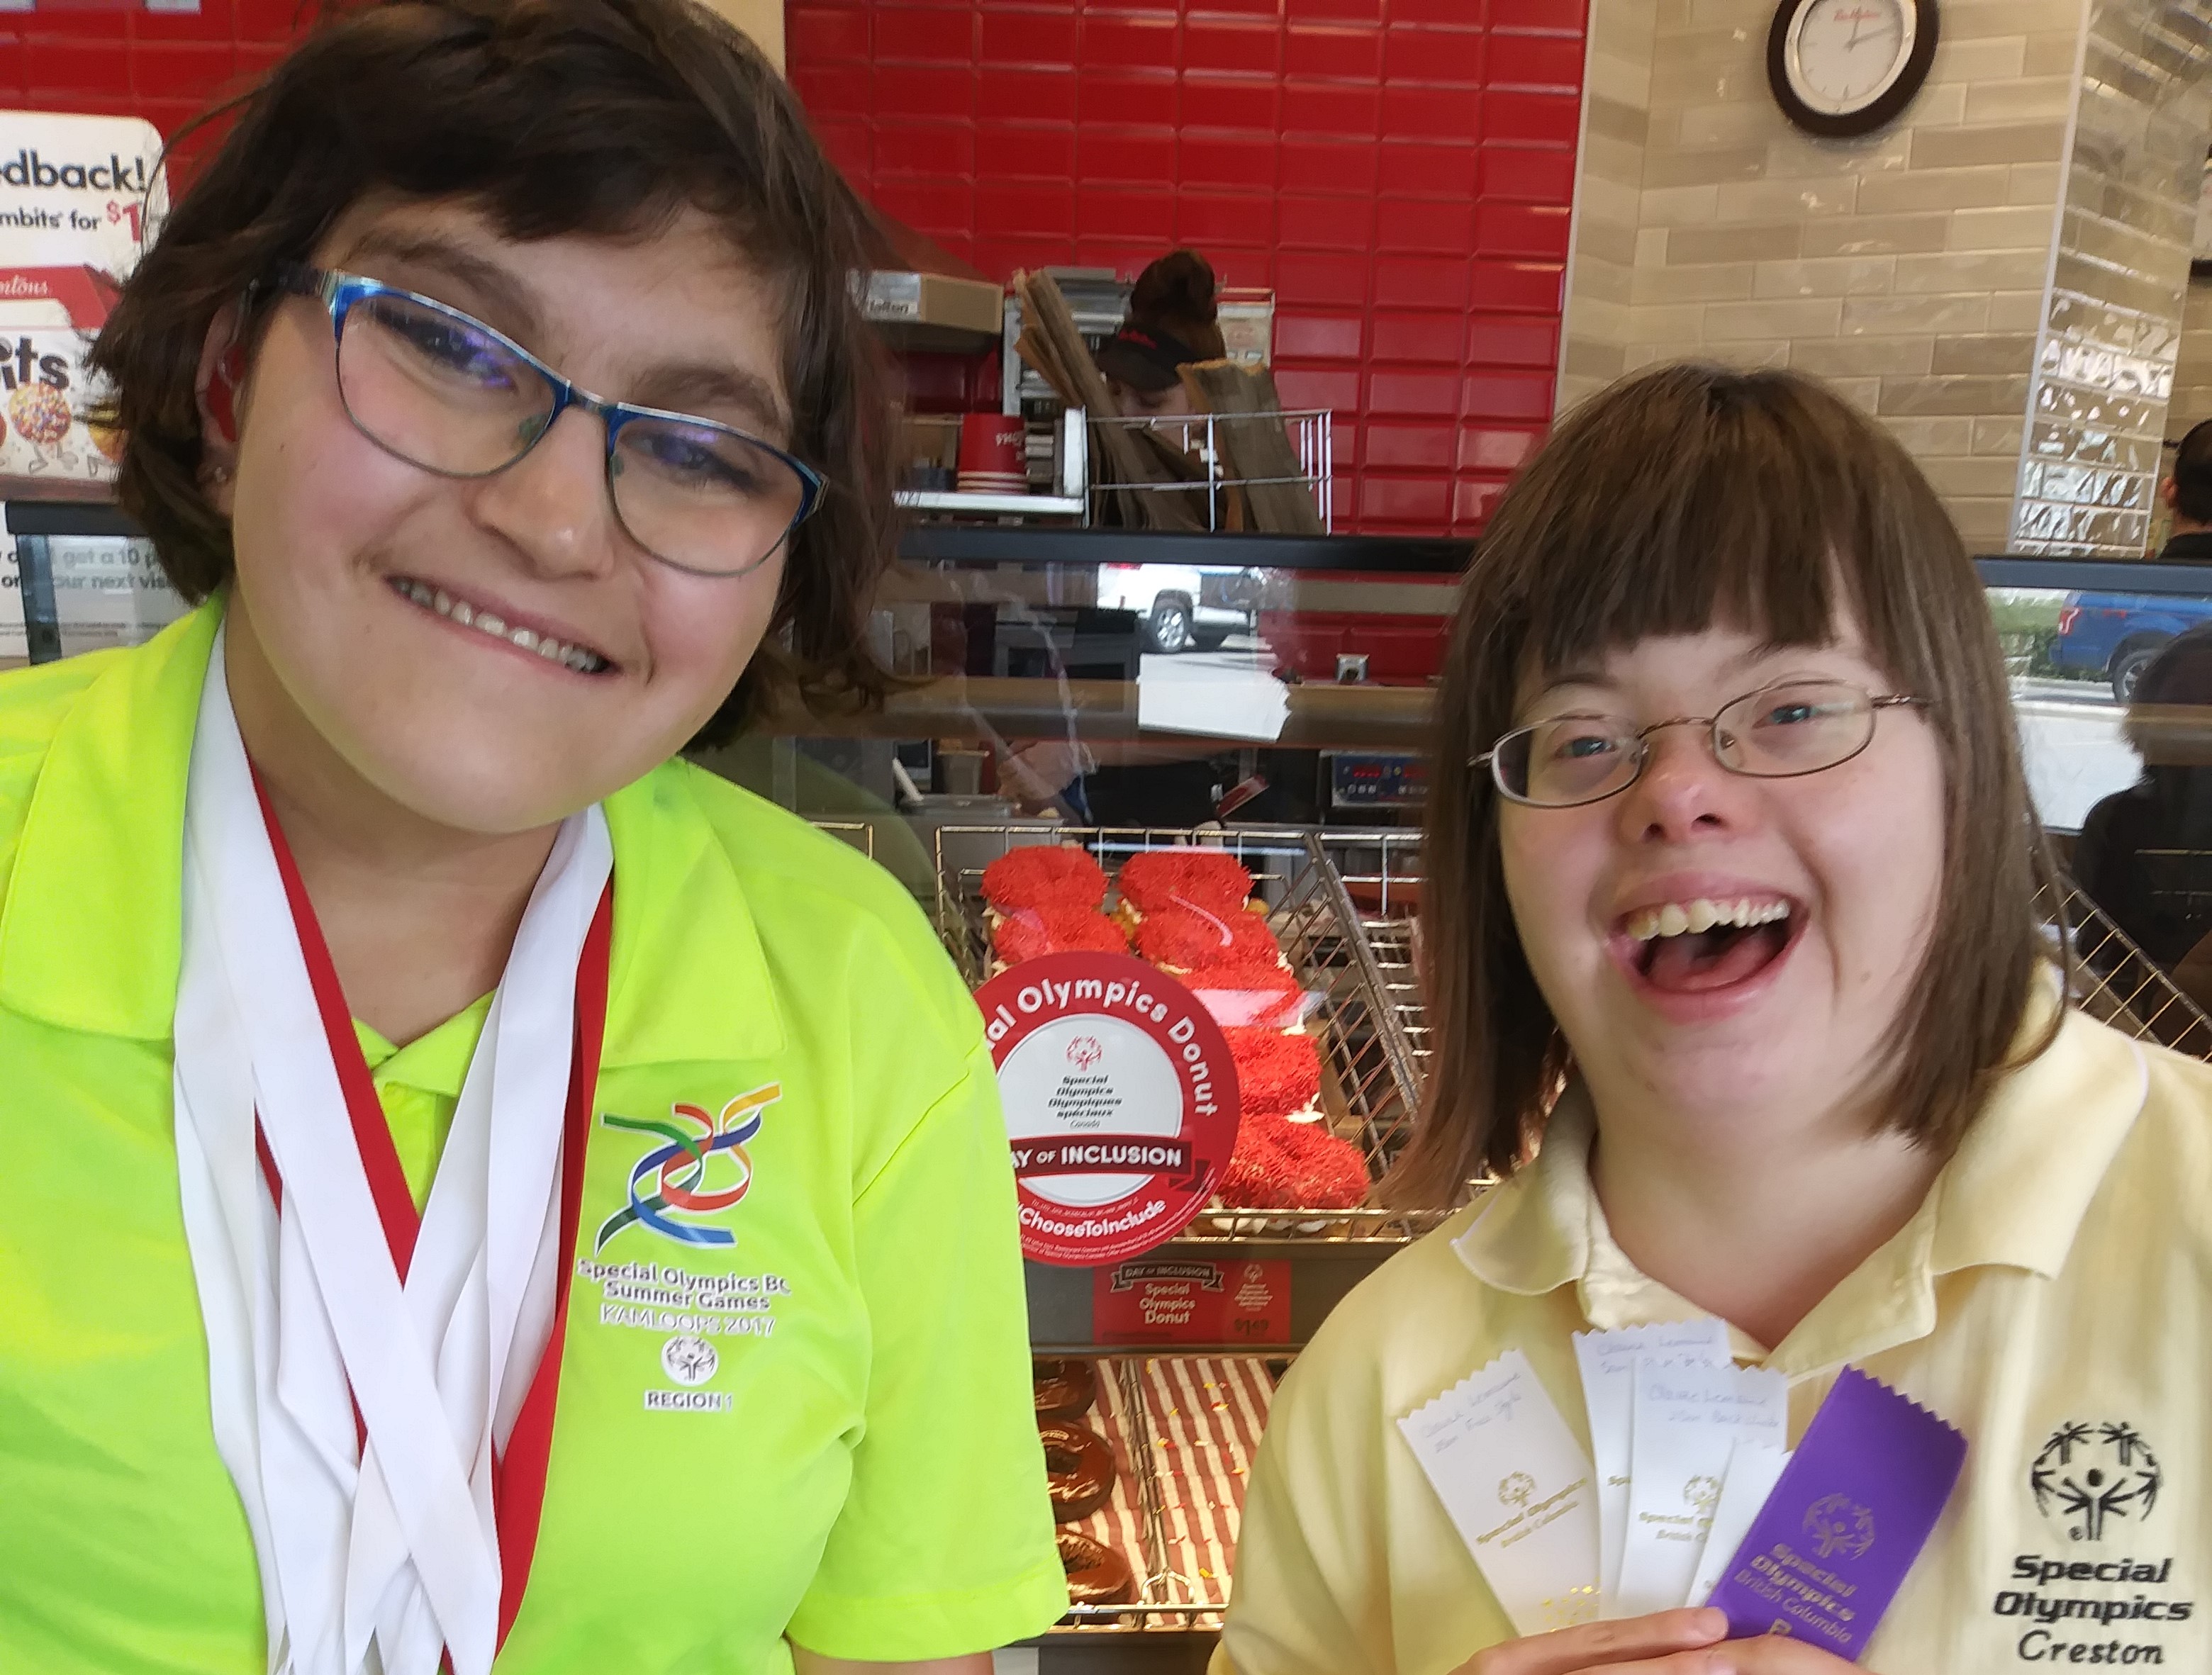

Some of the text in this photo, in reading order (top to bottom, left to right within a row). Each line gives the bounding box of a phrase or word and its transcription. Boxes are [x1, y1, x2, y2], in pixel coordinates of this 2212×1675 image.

[0, 148, 147, 193] dback!
[70, 208, 102, 231] for
[54, 576, 86, 590] our
[1017, 978, 1168, 1023] Olympics
[1168, 1016, 1218, 1116] Donut
[1057, 1087, 1113, 1097] Olympics
[1063, 1075, 1108, 1086] Special
[1049, 1097, 1122, 1109] Olympiques
[1010, 1148, 1034, 1168] AY
[1061, 1145, 1182, 1167] INCLUSION
[578, 1257, 659, 1282] Special
[661, 1267, 759, 1293] Olympics
[1145, 1283, 1190, 1298] Special
[604, 1280, 771, 1311] Summer Games
[1139, 1297, 1195, 1312] Olympics
[601, 1304, 776, 1337] KAMLOOPS 2017
[1145, 1311, 1190, 1324] Donut
[645, 1391, 733, 1411] REGION 1
[1770, 1543, 1858, 1597] Special
[2011, 1554, 2174, 1586] Special
[1751, 1554, 1855, 1621] Olympics
[1782, 1598, 1853, 1643] Columbia
[1994, 1591, 2194, 1625] Olympics
[2018, 1629, 2164, 1664] Creston
